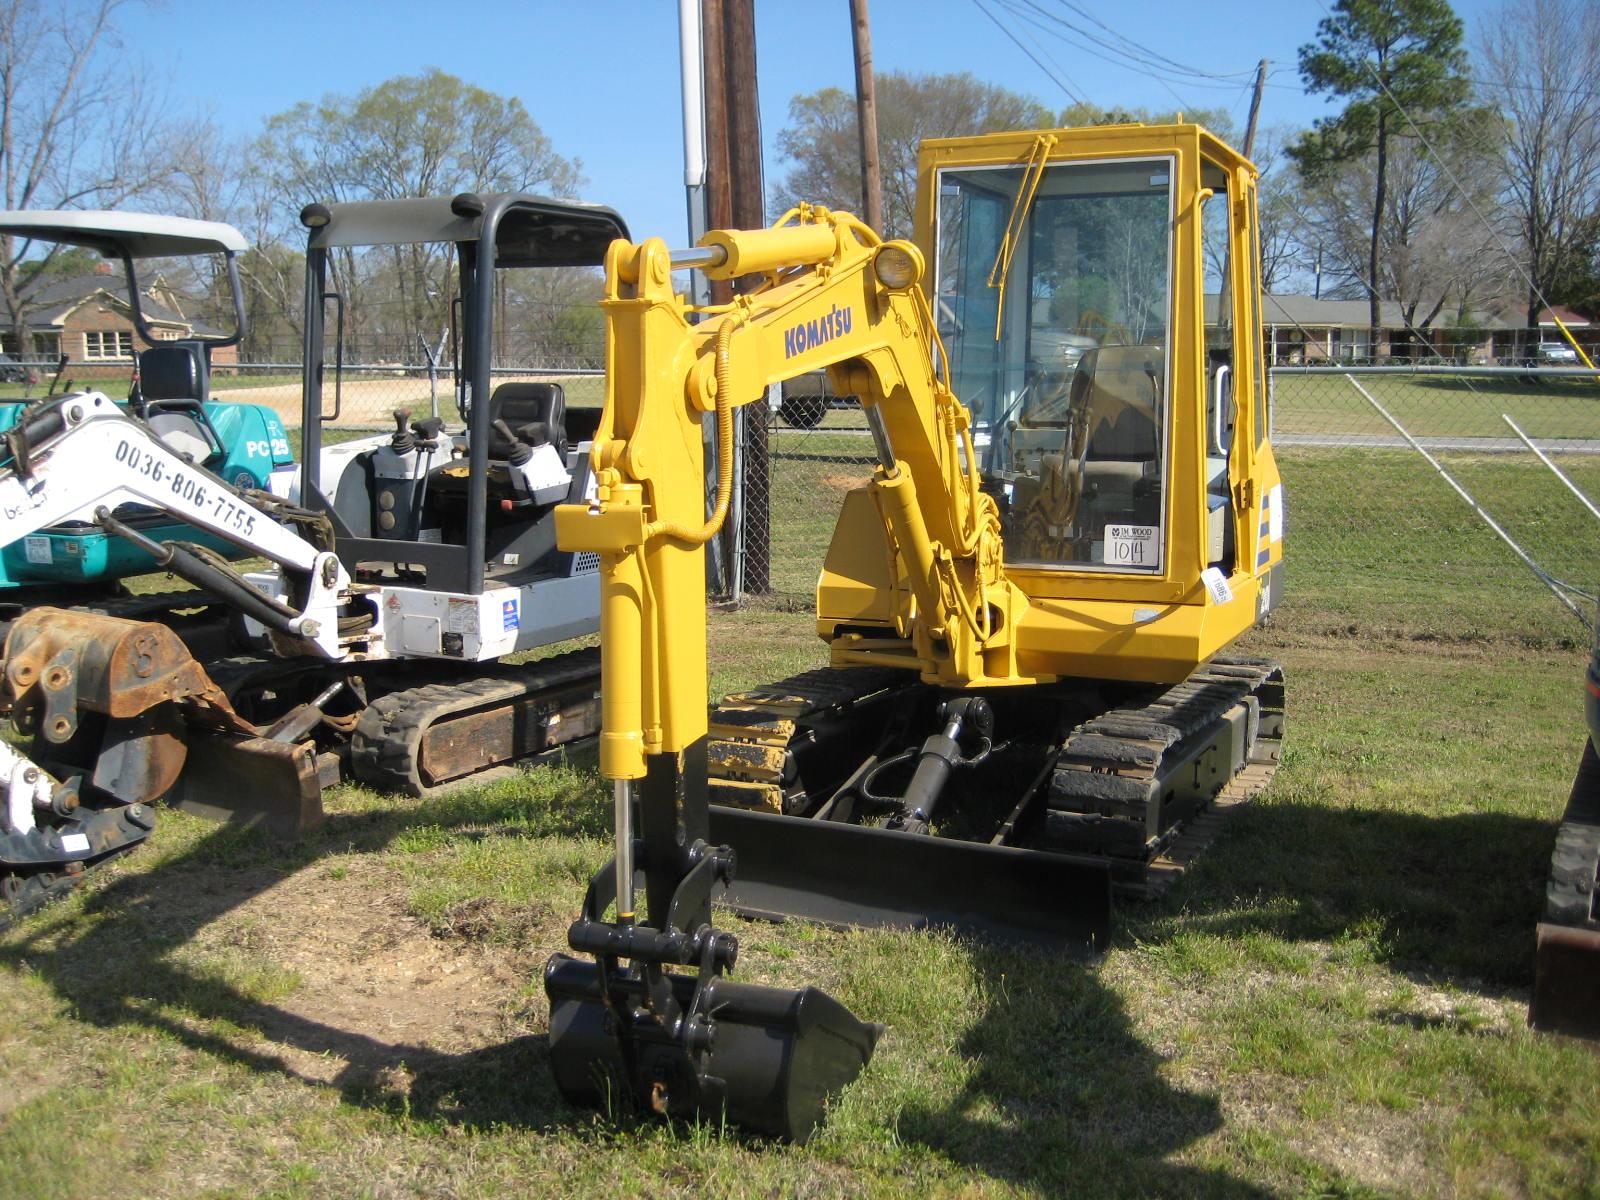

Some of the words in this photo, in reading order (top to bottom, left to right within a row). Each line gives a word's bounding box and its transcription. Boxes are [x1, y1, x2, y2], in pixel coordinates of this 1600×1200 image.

[784, 303, 852, 360] KOMATSU
[115, 439, 256, 536] 0036-806-7755
[1131, 527, 1152, 536] WOOD
[1114, 541, 1145, 563] 1014
